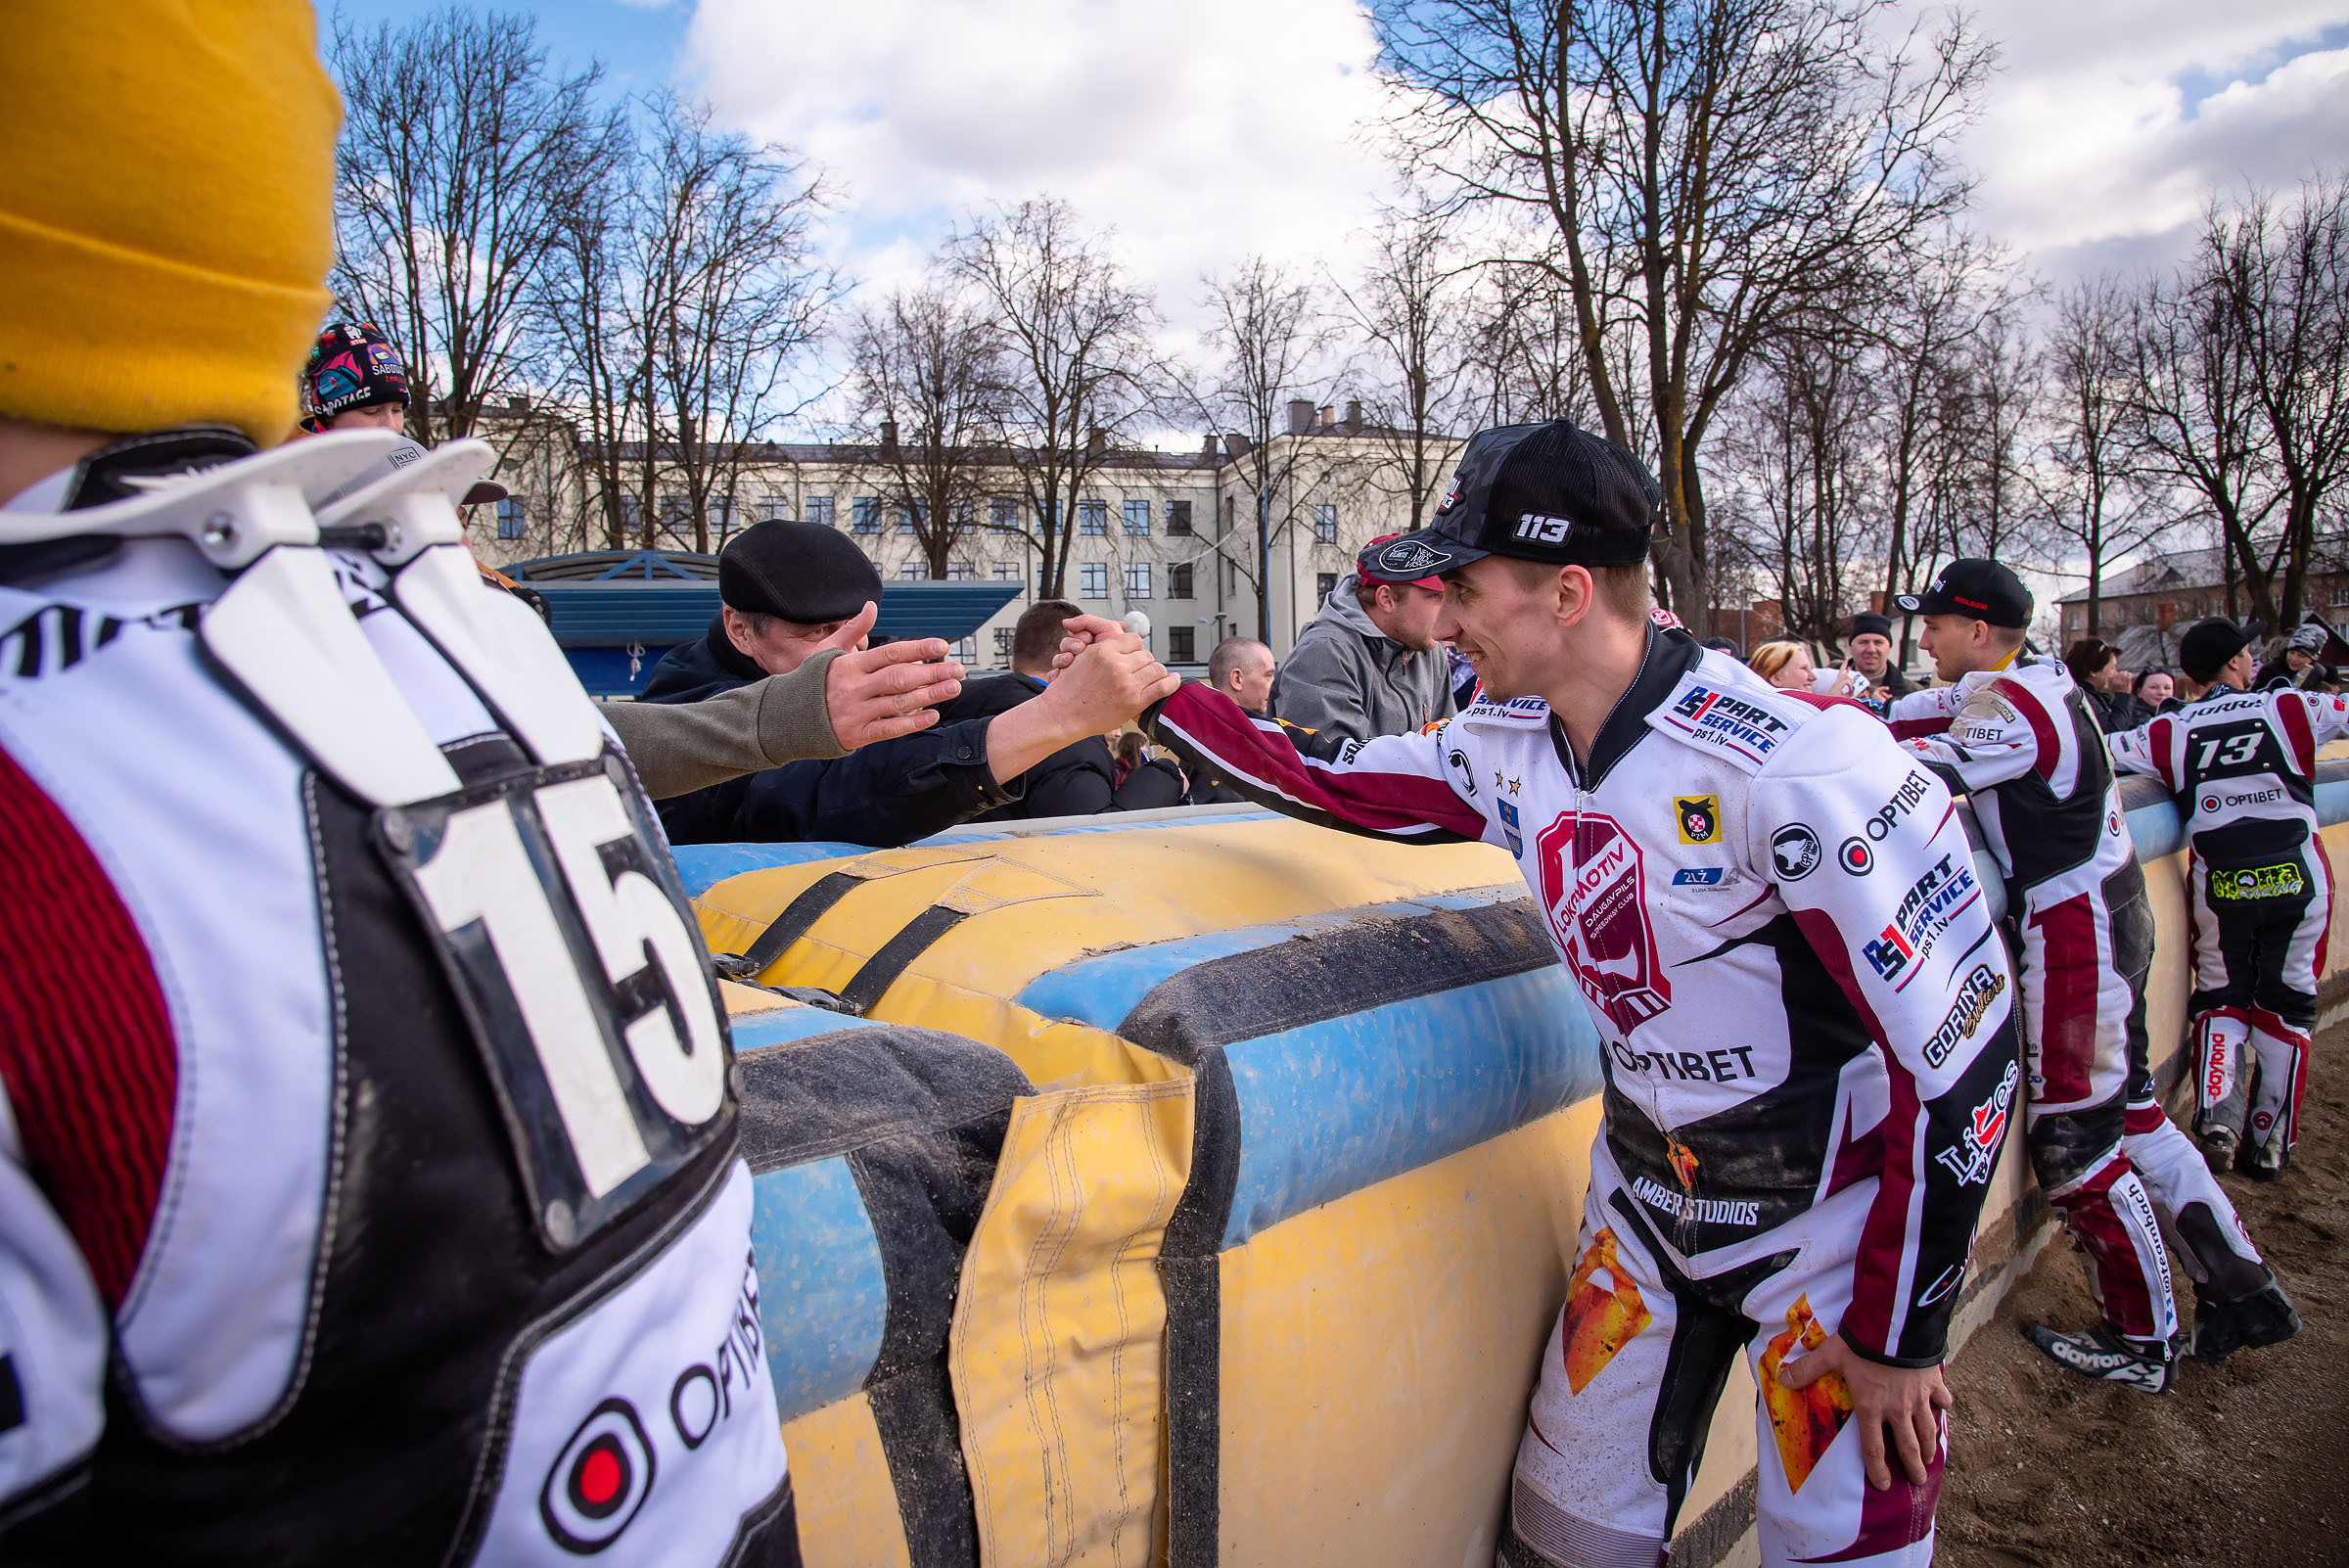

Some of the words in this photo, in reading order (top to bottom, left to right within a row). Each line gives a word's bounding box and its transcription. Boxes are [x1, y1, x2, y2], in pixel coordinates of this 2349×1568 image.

[394, 451, 417, 462] NYC
[1517, 514, 1570, 542] 113
[1471, 707, 1509, 718] ps1.lv
[1713, 696, 1788, 733] PART
[1692, 728, 1728, 746] ps1.lv
[1700, 714, 1775, 754] SERVICE
[2197, 732, 2264, 769] 13
[1865, 769, 1931, 842] OPTIBET
[2226, 789, 2282, 807] OPTIBET
[1691, 831, 1709, 841] PZM
[1586, 875, 1635, 929] DAUGAVPILS
[1895, 853, 1953, 932] PART
[1909, 869, 1974, 948] SERVICE
[2237, 880, 2302, 897] RACING
[1589, 907, 1619, 941] SPEEDWAY
[1617, 892, 1635, 910] CLUB
[1920, 916, 1950, 959] ps1.lv
[415, 775, 724, 1200] 15
[1962, 973, 2005, 1039] Brothers
[1924, 965, 1995, 1067] GORINA
[1611, 1044, 1756, 1083] OPTIBET
[1632, 1176, 1682, 1217] AMBER
[1683, 1197, 1760, 1226] STUDIOS
[669, 1245, 762, 1452] OPTIBE
[2051, 1341, 2129, 1369] dayton
